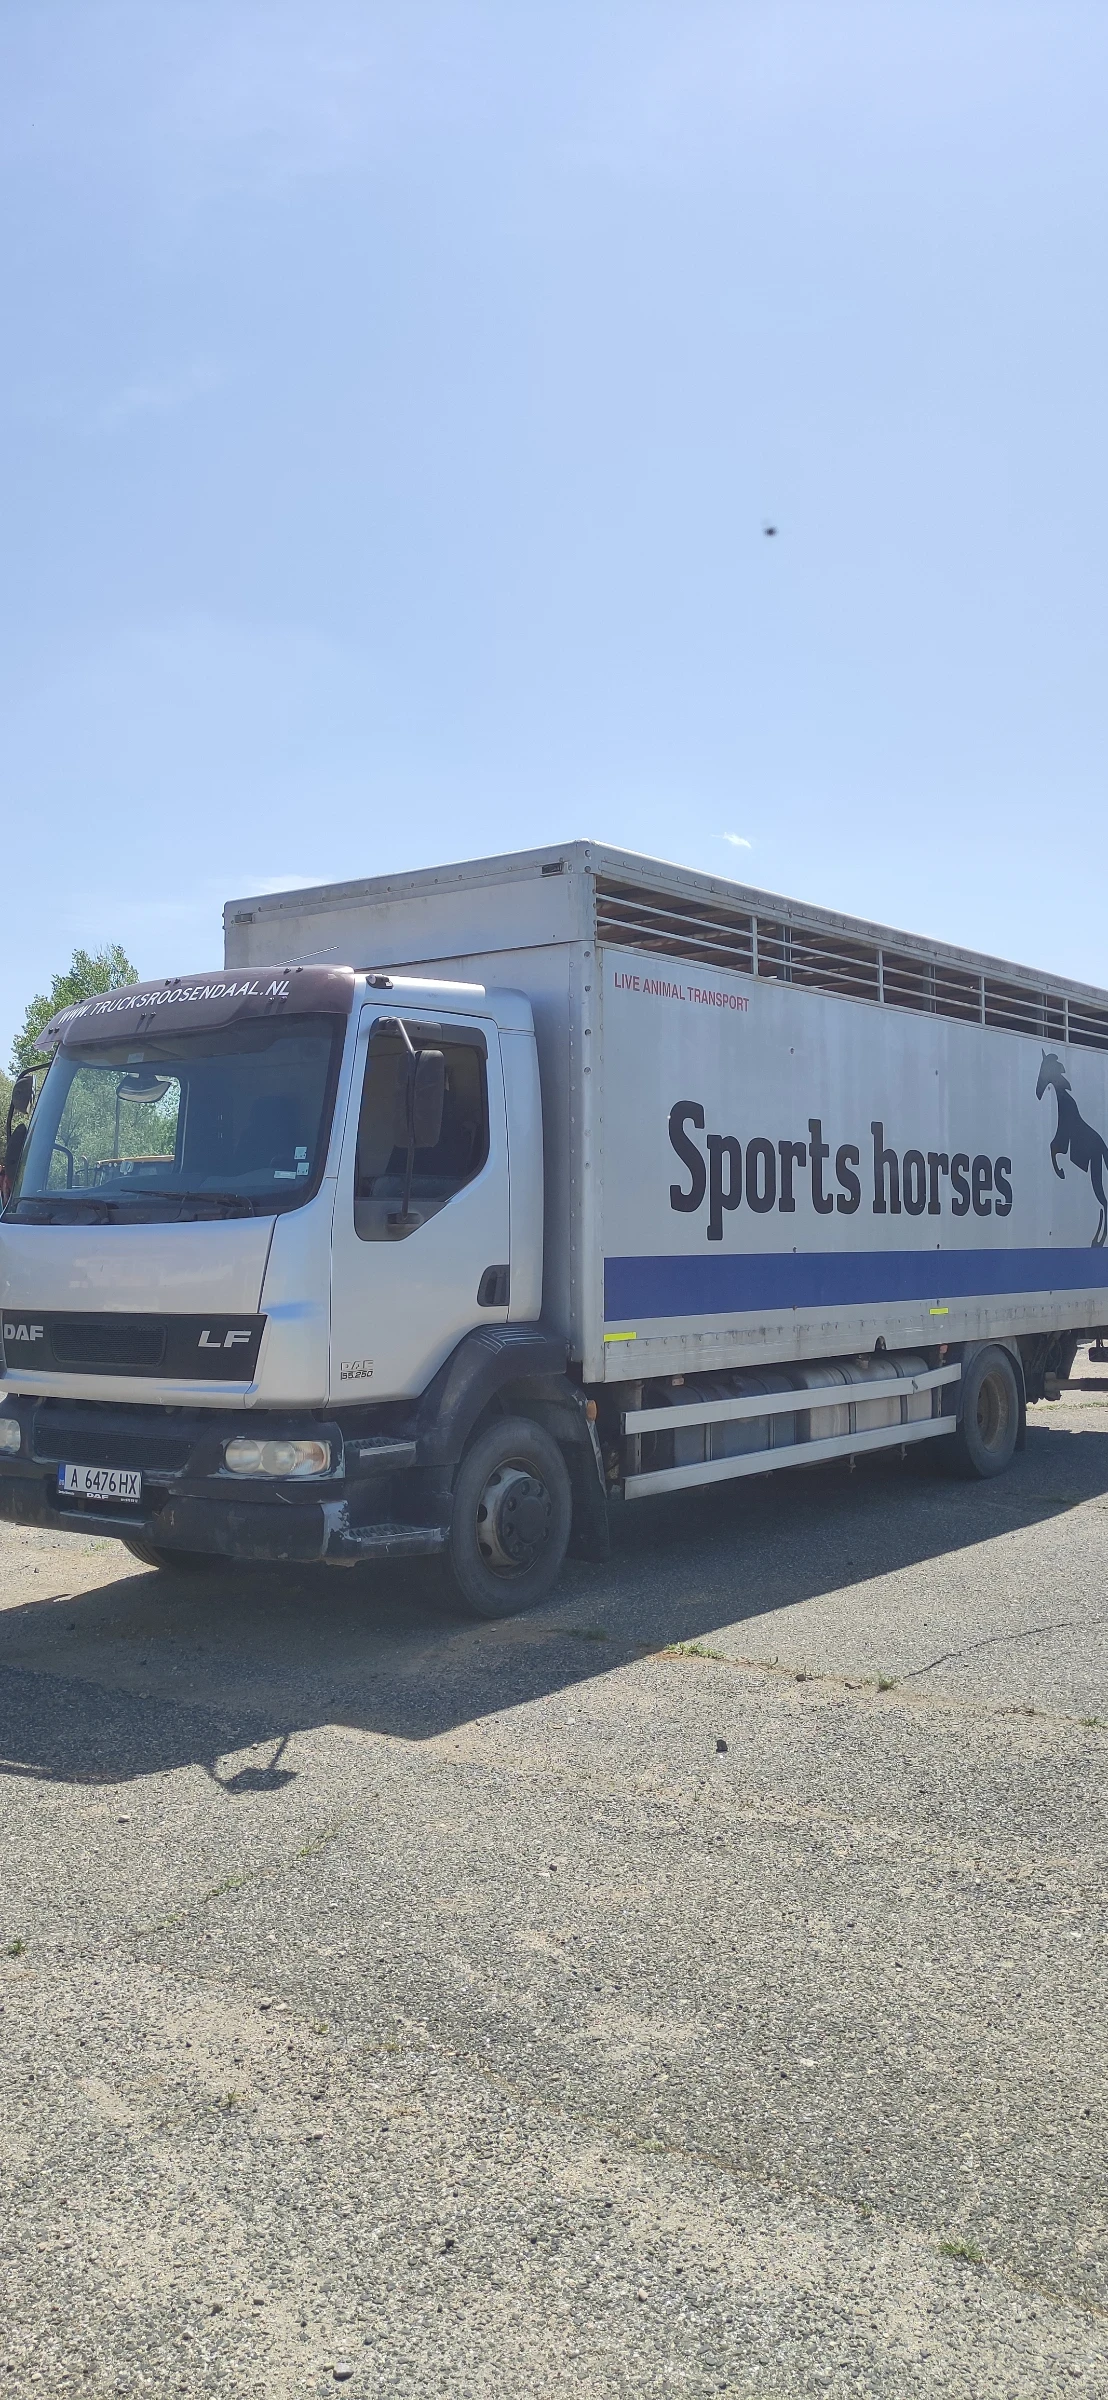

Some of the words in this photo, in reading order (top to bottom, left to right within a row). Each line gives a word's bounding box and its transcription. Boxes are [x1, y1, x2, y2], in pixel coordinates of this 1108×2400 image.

[614, 972, 640, 992] LIVE
[642, 978, 685, 1001] ANIMAL
[687, 986, 750, 1012] TRANSPORT
[57, 980, 291, 1025] WWW.TRUCKSROOSENDAAL.NL
[668, 1100, 862, 1241] Sports
[870, 1121, 1013, 1218] horses
[4, 1323, 44, 1341] DAF
[198, 1330, 252, 1348] LF
[340, 1360, 374, 1371] DAF
[70, 1468, 78, 1488] A
[86, 1492, 109, 1500] DAF
